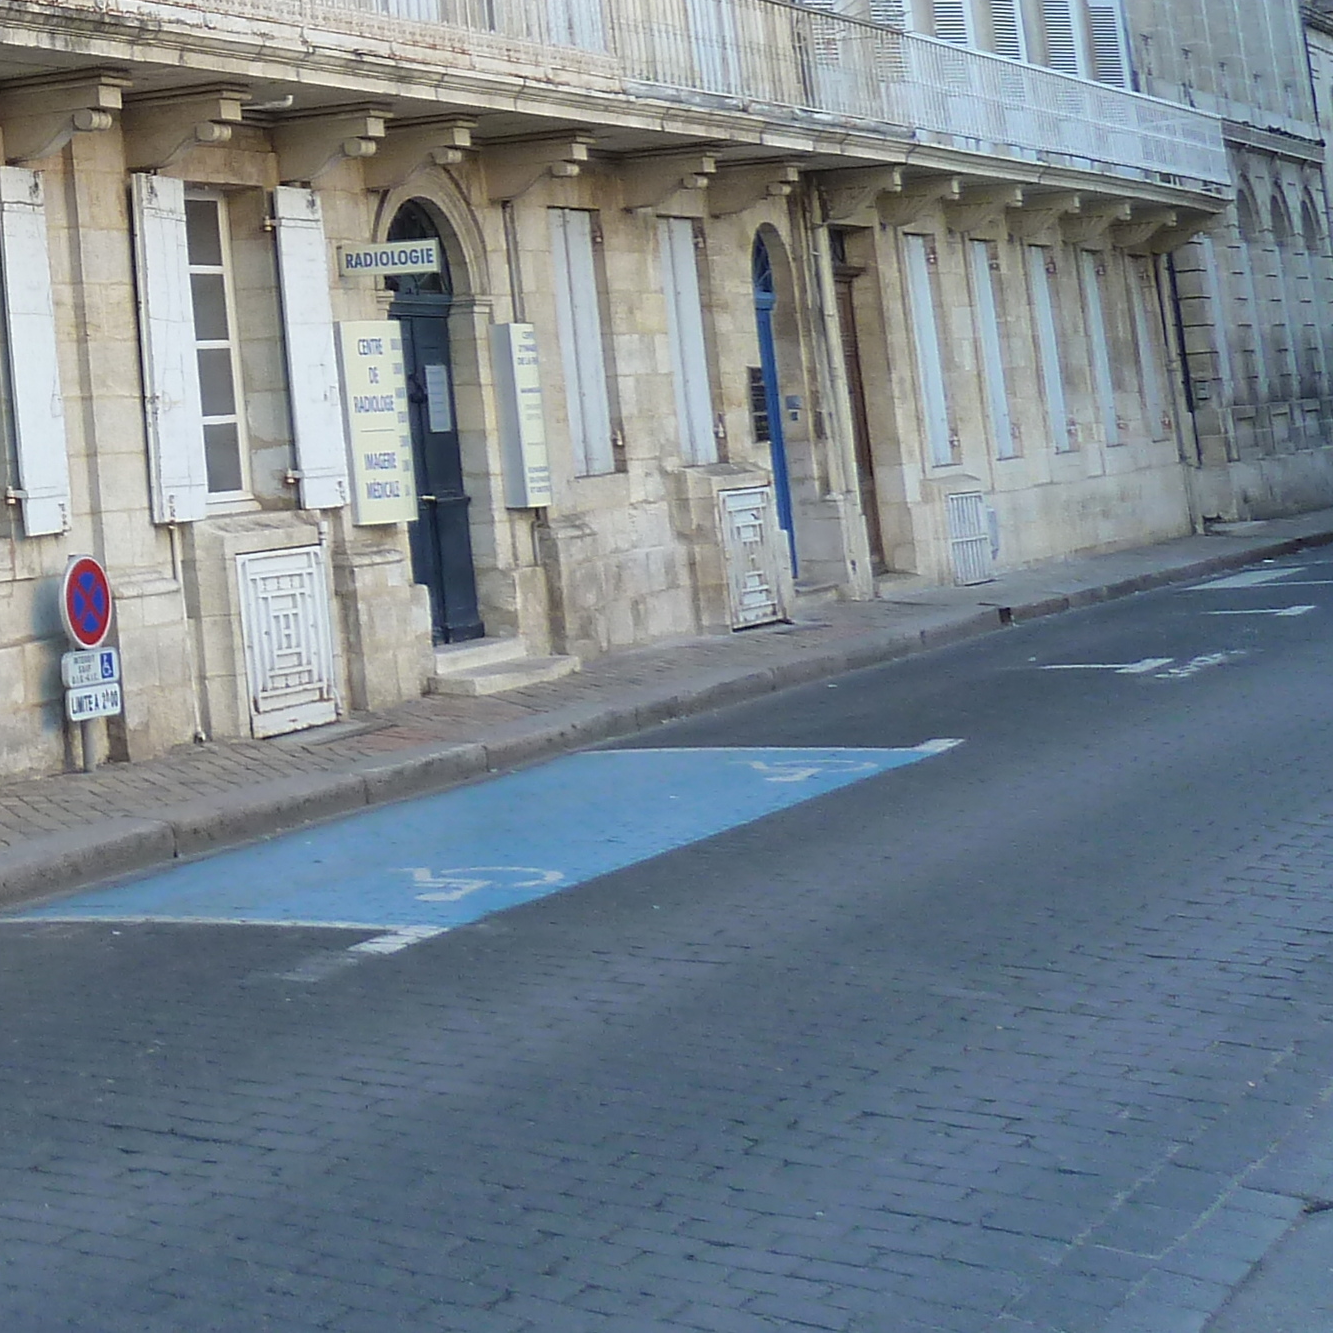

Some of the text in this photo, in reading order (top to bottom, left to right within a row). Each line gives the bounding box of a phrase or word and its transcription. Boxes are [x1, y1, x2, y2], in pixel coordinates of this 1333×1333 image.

[345, 248, 434, 269] RADIOLOGIE
[358, 338, 383, 356] CENTRE
[368, 367, 380, 384] DE
[353, 395, 395, 414] RADIOLOGIE
[364, 452, 397, 470] IMAGERIE
[366, 478, 400, 499] MÉDICALE
